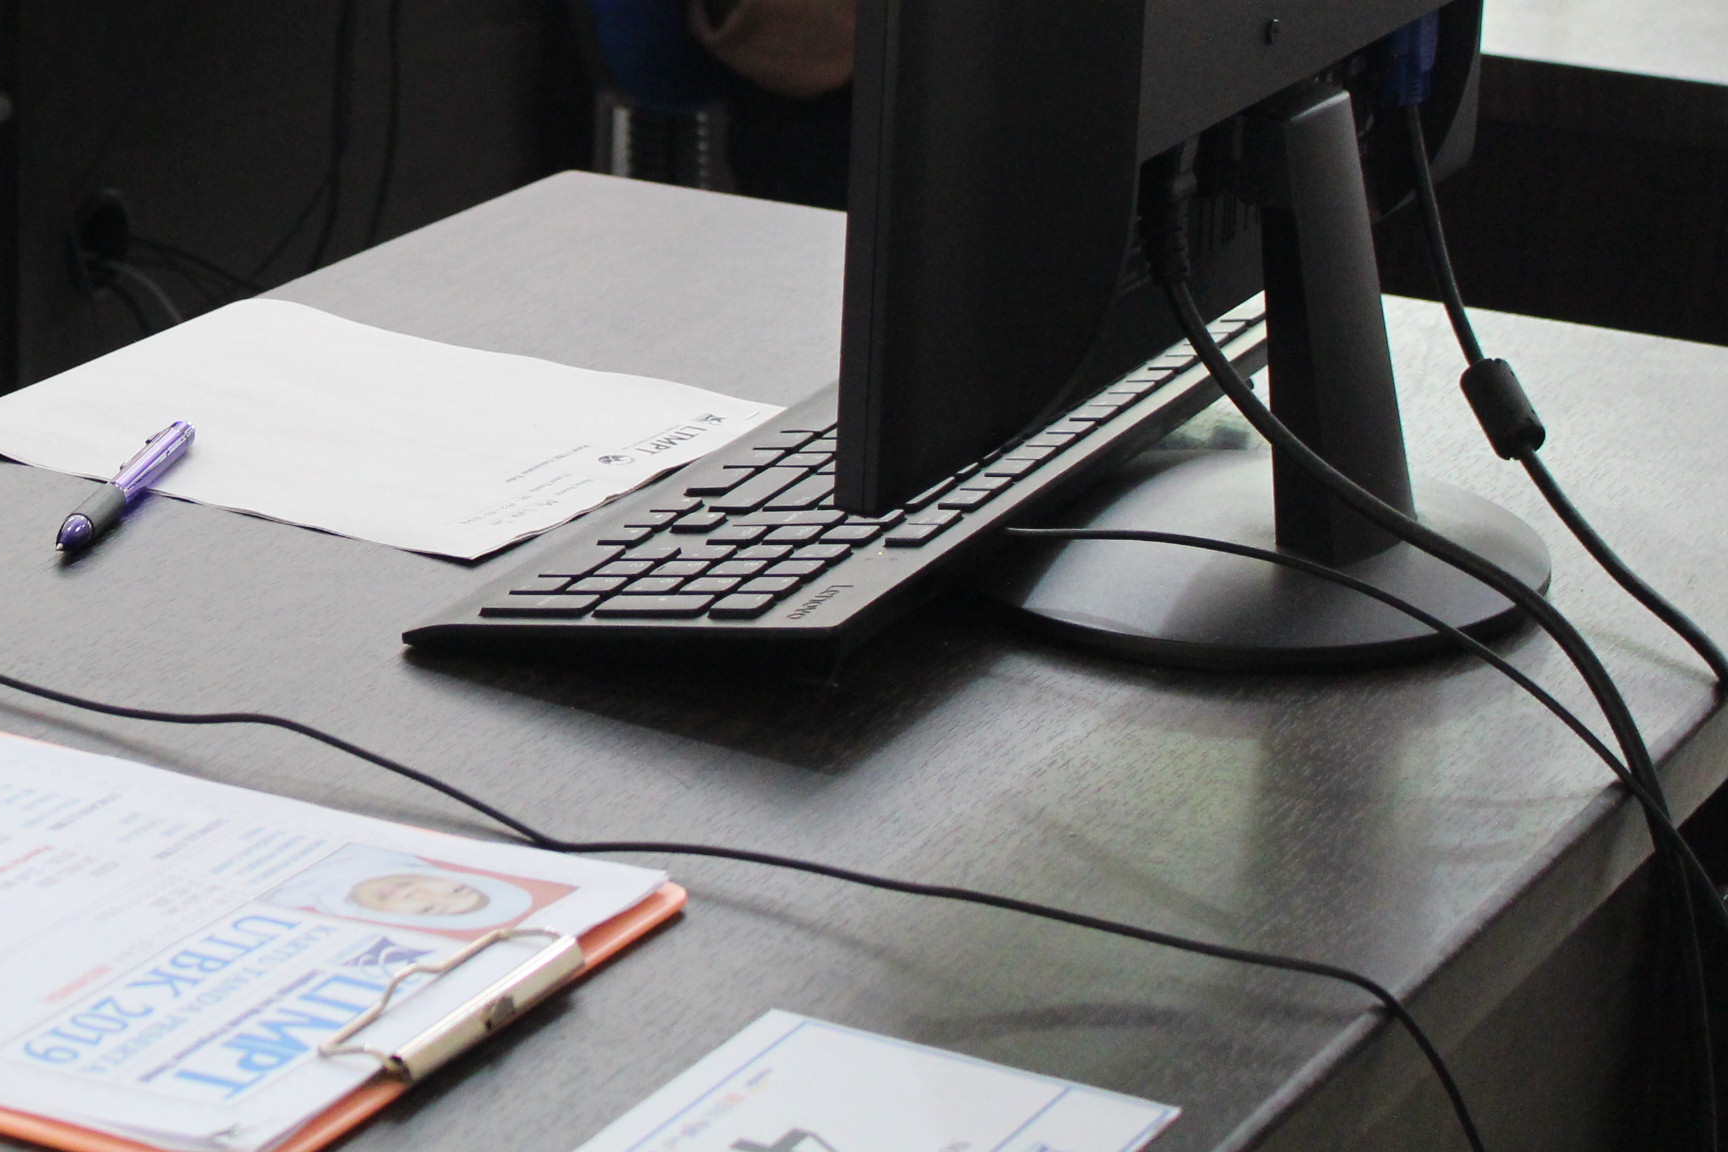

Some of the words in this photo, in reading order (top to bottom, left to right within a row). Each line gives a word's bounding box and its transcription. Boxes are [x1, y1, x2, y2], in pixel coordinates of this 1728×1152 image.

[636, 424, 707, 455] LTMPT
[785, 584, 854, 620] Lenovo
[125, 914, 302, 998] UTBK
[24, 995, 154, 1065] 2019
